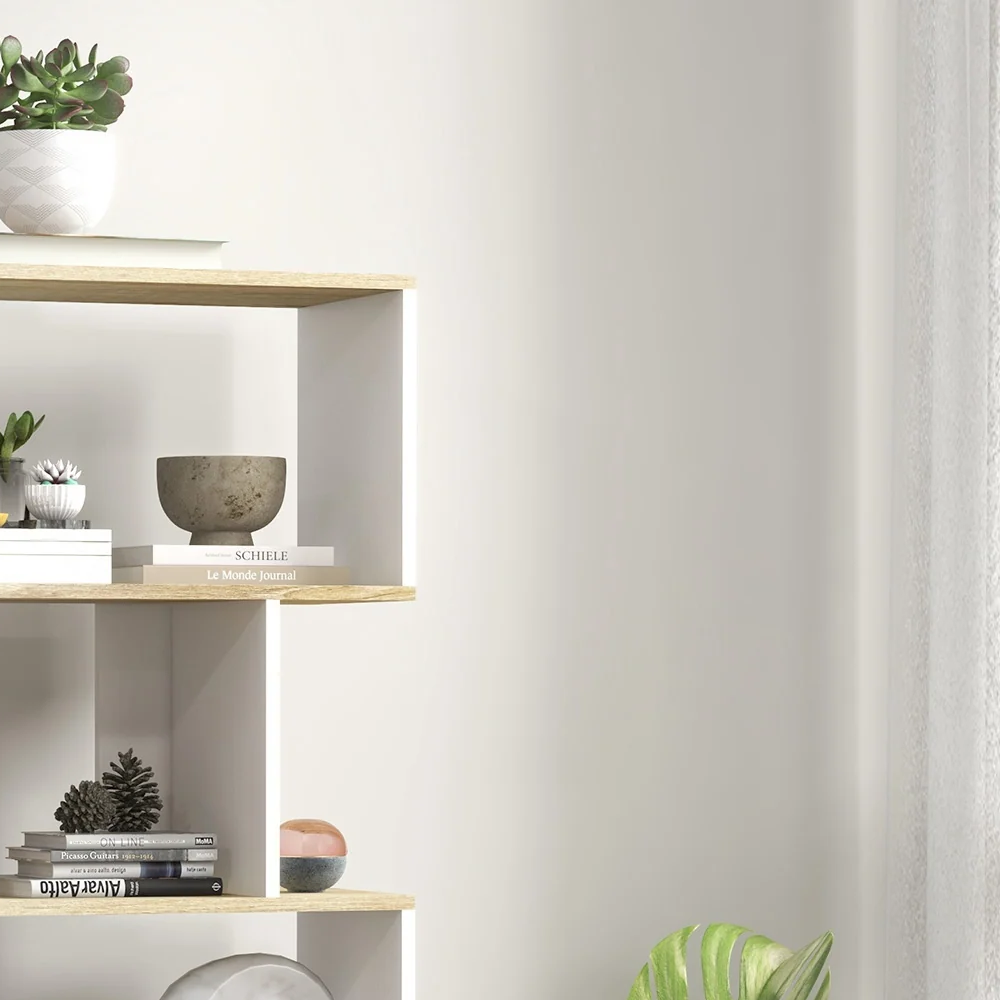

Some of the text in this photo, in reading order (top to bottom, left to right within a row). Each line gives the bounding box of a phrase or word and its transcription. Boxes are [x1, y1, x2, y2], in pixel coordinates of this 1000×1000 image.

[235, 551, 288, 561] SCHIELE
[207, 570, 296, 581] Le Monde Journal
[100, 838, 115, 847] ON
[121, 837, 145, 847] LINE
[61, 852, 88, 860] Picasso
[89, 851, 119, 860] Guitars
